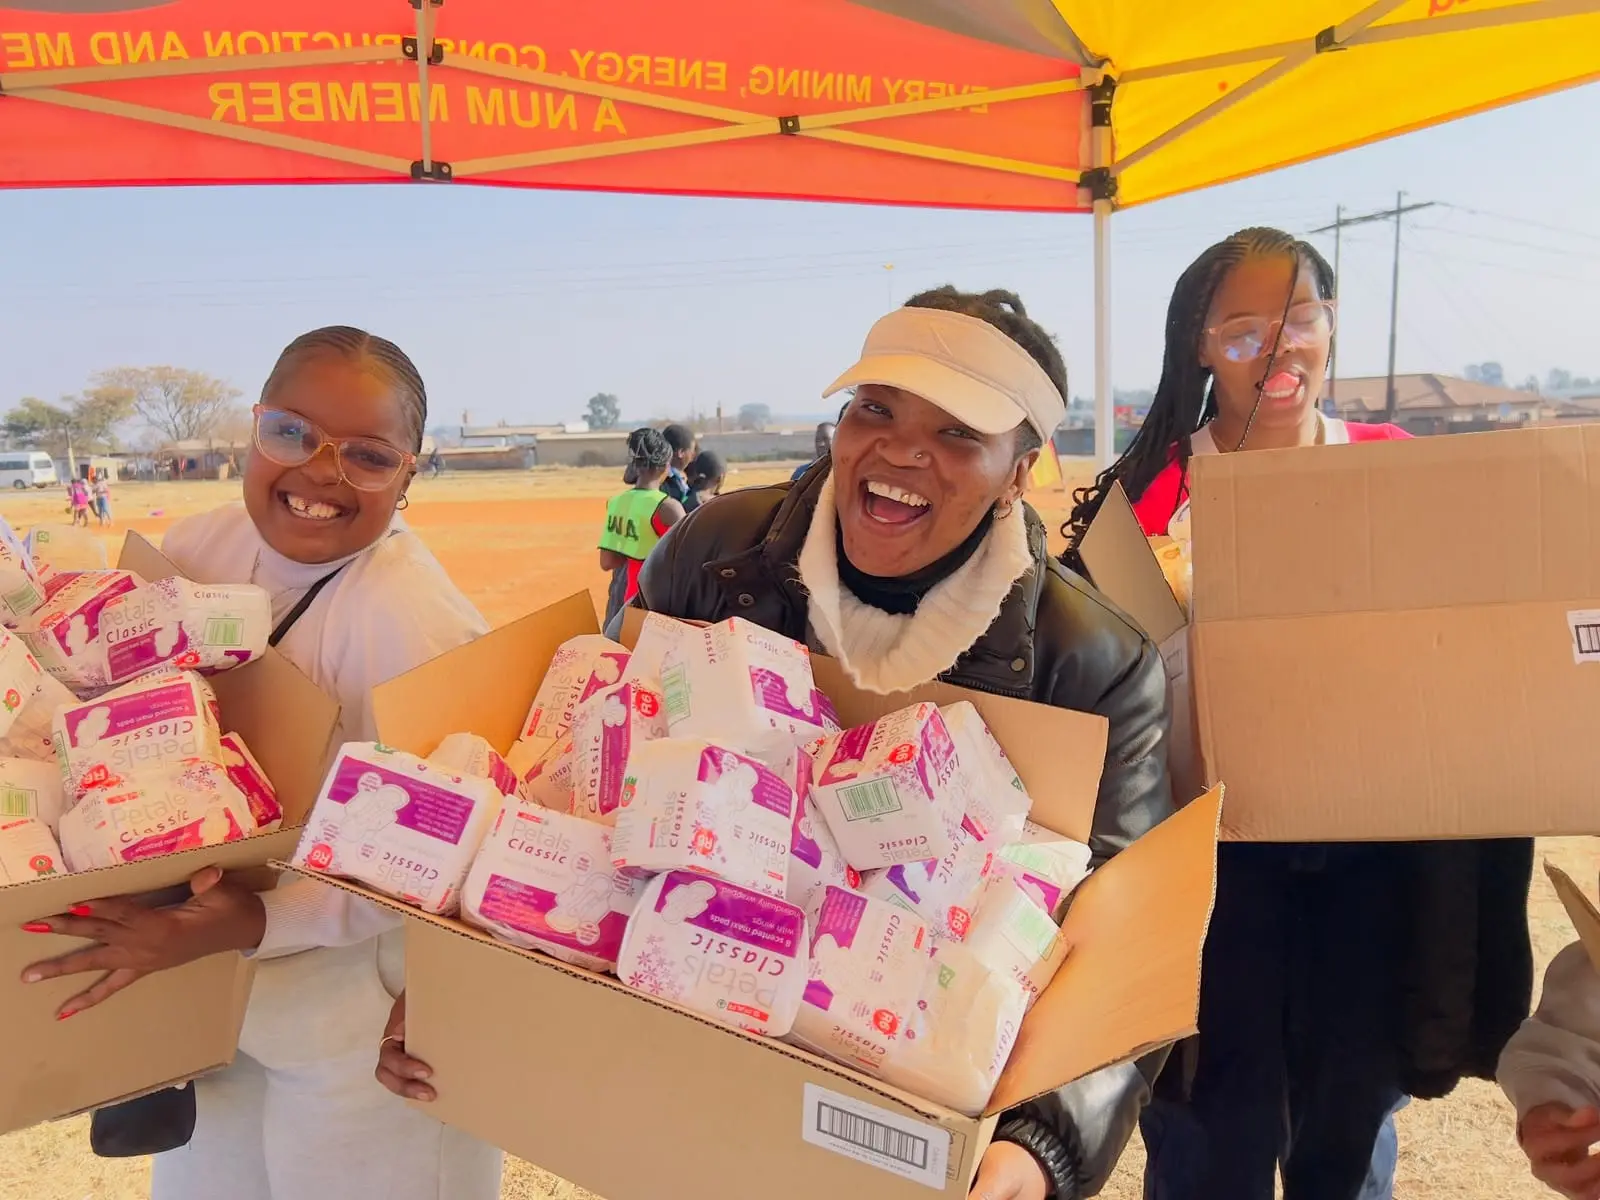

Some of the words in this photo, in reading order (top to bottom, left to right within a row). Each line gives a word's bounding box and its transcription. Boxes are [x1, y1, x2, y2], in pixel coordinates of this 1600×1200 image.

[607, 514, 639, 541] WA
[194, 591, 231, 600] Classic
[106, 618, 155, 643] Classic
[704, 628, 716, 664] lassic
[545, 672, 573, 739] Petals
[555, 676, 586, 741] Classic
[640, 693, 653, 715] R6
[111, 720, 194, 747] Classic
[111, 738, 197, 769] Petals
[588, 734, 601, 815] Classic
[656, 790, 677, 849] Petals
[669, 790, 687, 848] Classic
[511, 818, 573, 853] Petals
[748, 831, 786, 855] Classic
[878, 835, 928, 851] Classic
[313, 849, 332, 864] R6
[507, 837, 568, 865] Classic
[382, 851, 439, 880] Classic
[709, 914, 731, 927] pads
[752, 927, 785, 944] scented
[785, 938, 792, 947] 8
[876, 914, 900, 964] Classic
[689, 932, 786, 977] Classic
[683, 954, 778, 1009] Petals
[878, 1012, 893, 1032] R6
[831, 1024, 887, 1056] Classic
